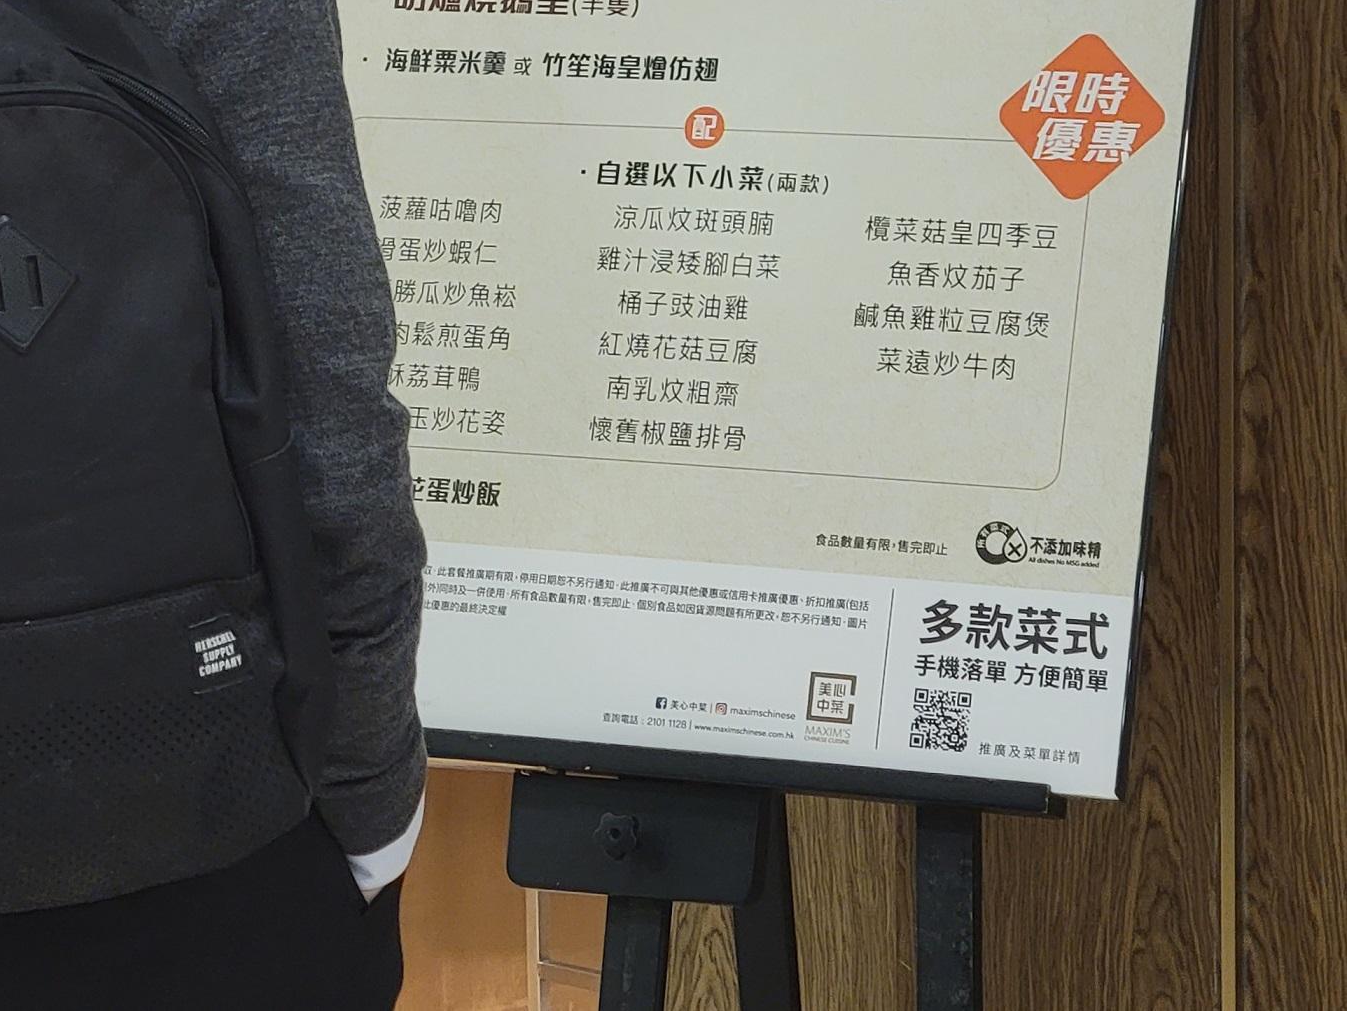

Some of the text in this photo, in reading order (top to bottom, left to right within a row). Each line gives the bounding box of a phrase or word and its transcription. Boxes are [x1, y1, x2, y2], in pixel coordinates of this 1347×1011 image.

[384, 48, 719, 82] 海鮮粟米羹 或 竹笙海皇燴仿翅
[1021, 70, 1131, 116] 限時
[692, 114, 718, 141] 配
[1032, 118, 1141, 163] 優惠
[597, 160, 830, 195] 自選以下小菜(兩款)
[379, 195, 502, 224] 菠蘿咕嚕肉
[613, 204, 774, 236] 涼瓜炆斑頭腩
[865, 215, 1058, 250] 欖菜菇皇四季豆
[597, 246, 781, 278] 雞汁浸矮腳白菜
[887, 260, 1024, 292] 魚香炆茄子
[390, 279, 516, 308] 勝瓜炒魚崧
[618, 289, 749, 320] 桶子豉油雞
[395, 320, 511, 351] 肉鬆煎蛋角
[853, 302, 1050, 339] 鹹魚雞粒豆腐煲
[598, 331, 759, 365] 紅燒花菇豆腐
[876, 347, 1016, 381] 菜遠炒牛肉
[607, 375, 739, 407] 南乳炆粗齋
[589, 416, 746, 451] 懷舊椒鹽排骨
[1030, 536, 1101, 559] 不添加味精
[920, 599, 1110, 660] 多款菜式
[199, 654, 242, 677] COMPANY
[203, 643, 235, 663] SUPPLY
[914, 654, 1109, 693] 手機落單 方便簡單
[818, 682, 846, 698] 美心
[670, 700, 796, 720] 美心中菜 maximschinese
[817, 699, 844, 714] 中菜
[647, 717, 666, 728] 2101
[668, 719, 687, 729] 1128
[694, 723, 794, 739] www.maximschinese.com.hk
[805, 725, 851, 739] MAXIM'S
[979, 742, 1081, 765] 推廣及菜單詳情
